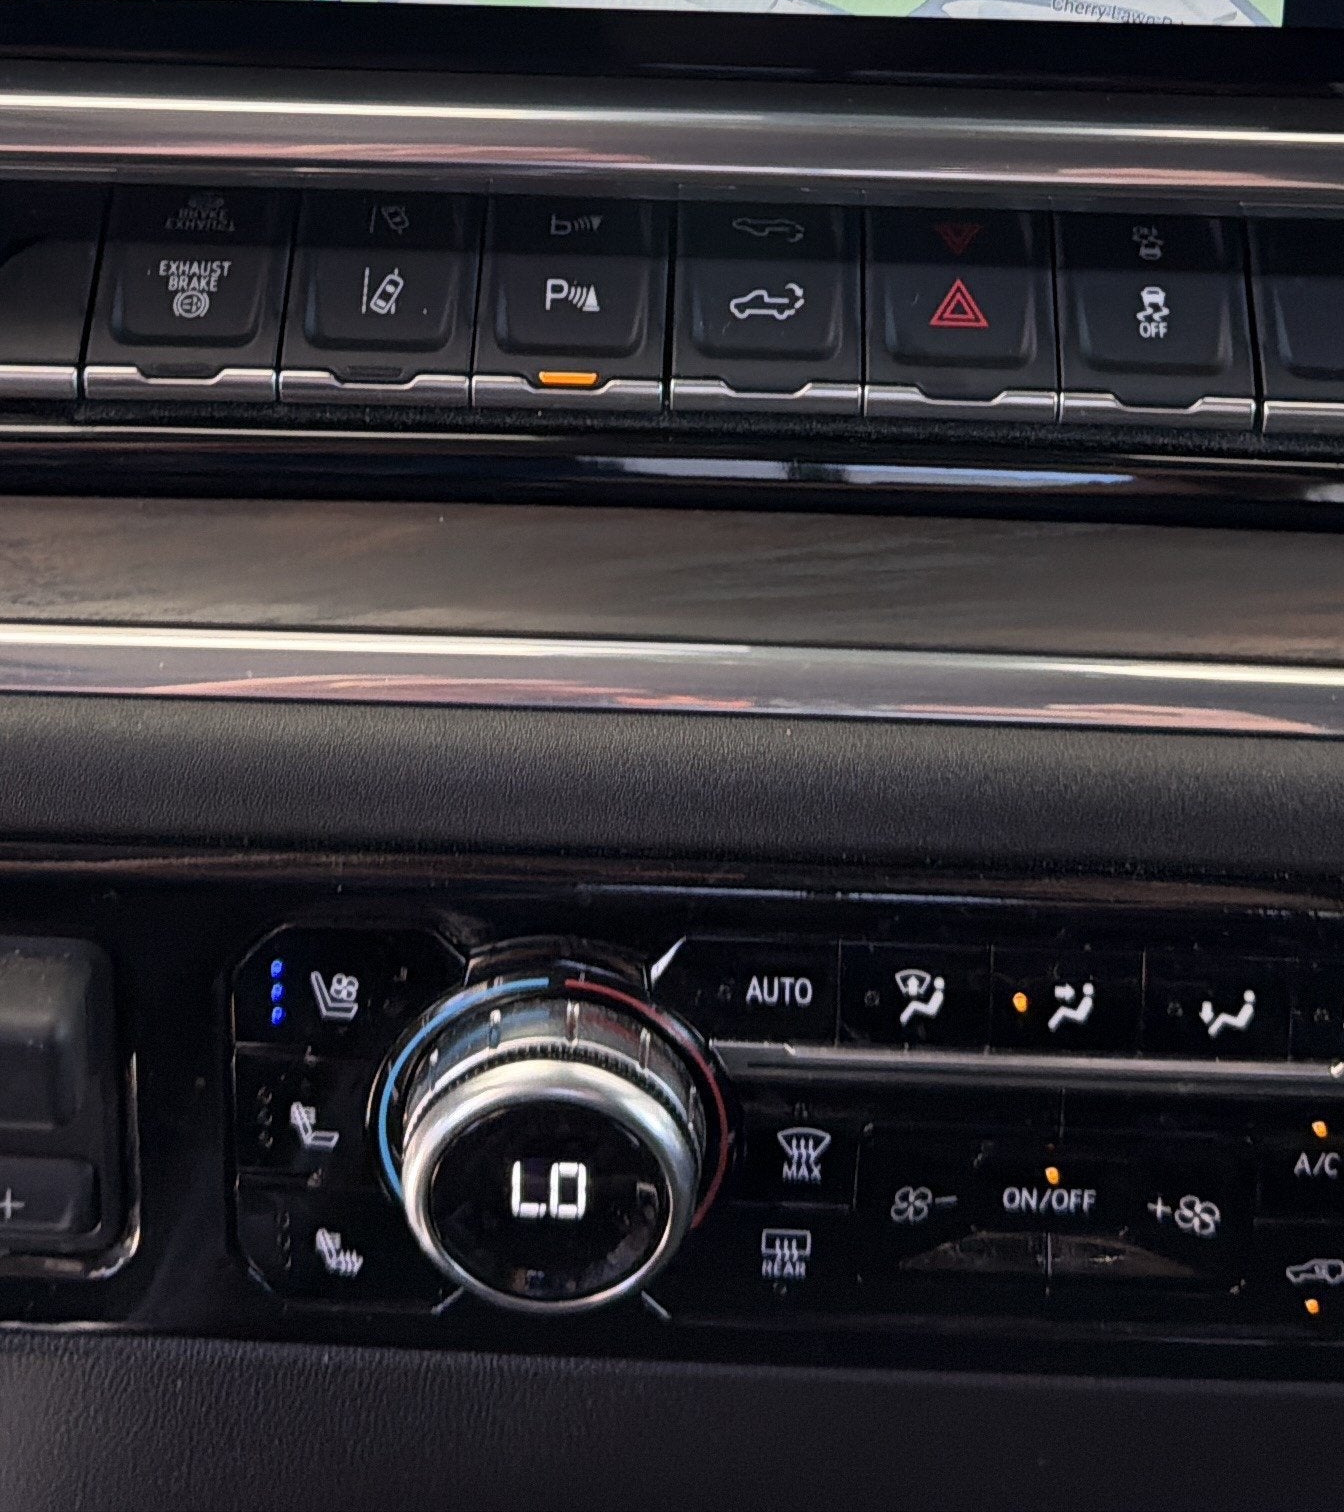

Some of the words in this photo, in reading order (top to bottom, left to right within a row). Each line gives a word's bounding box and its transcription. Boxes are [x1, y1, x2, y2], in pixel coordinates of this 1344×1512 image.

[159, 259, 231, 277] EXHAUST
[168, 275, 218, 292] BRAKE
[1140, 321, 1168, 338] OFF
[746, 977, 813, 1006] AUTO
[783, 1161, 822, 1184] MAX
[1294, 1152, 1340, 1179] A/C
[1003, 1187, 1096, 1214] ON/OFF
